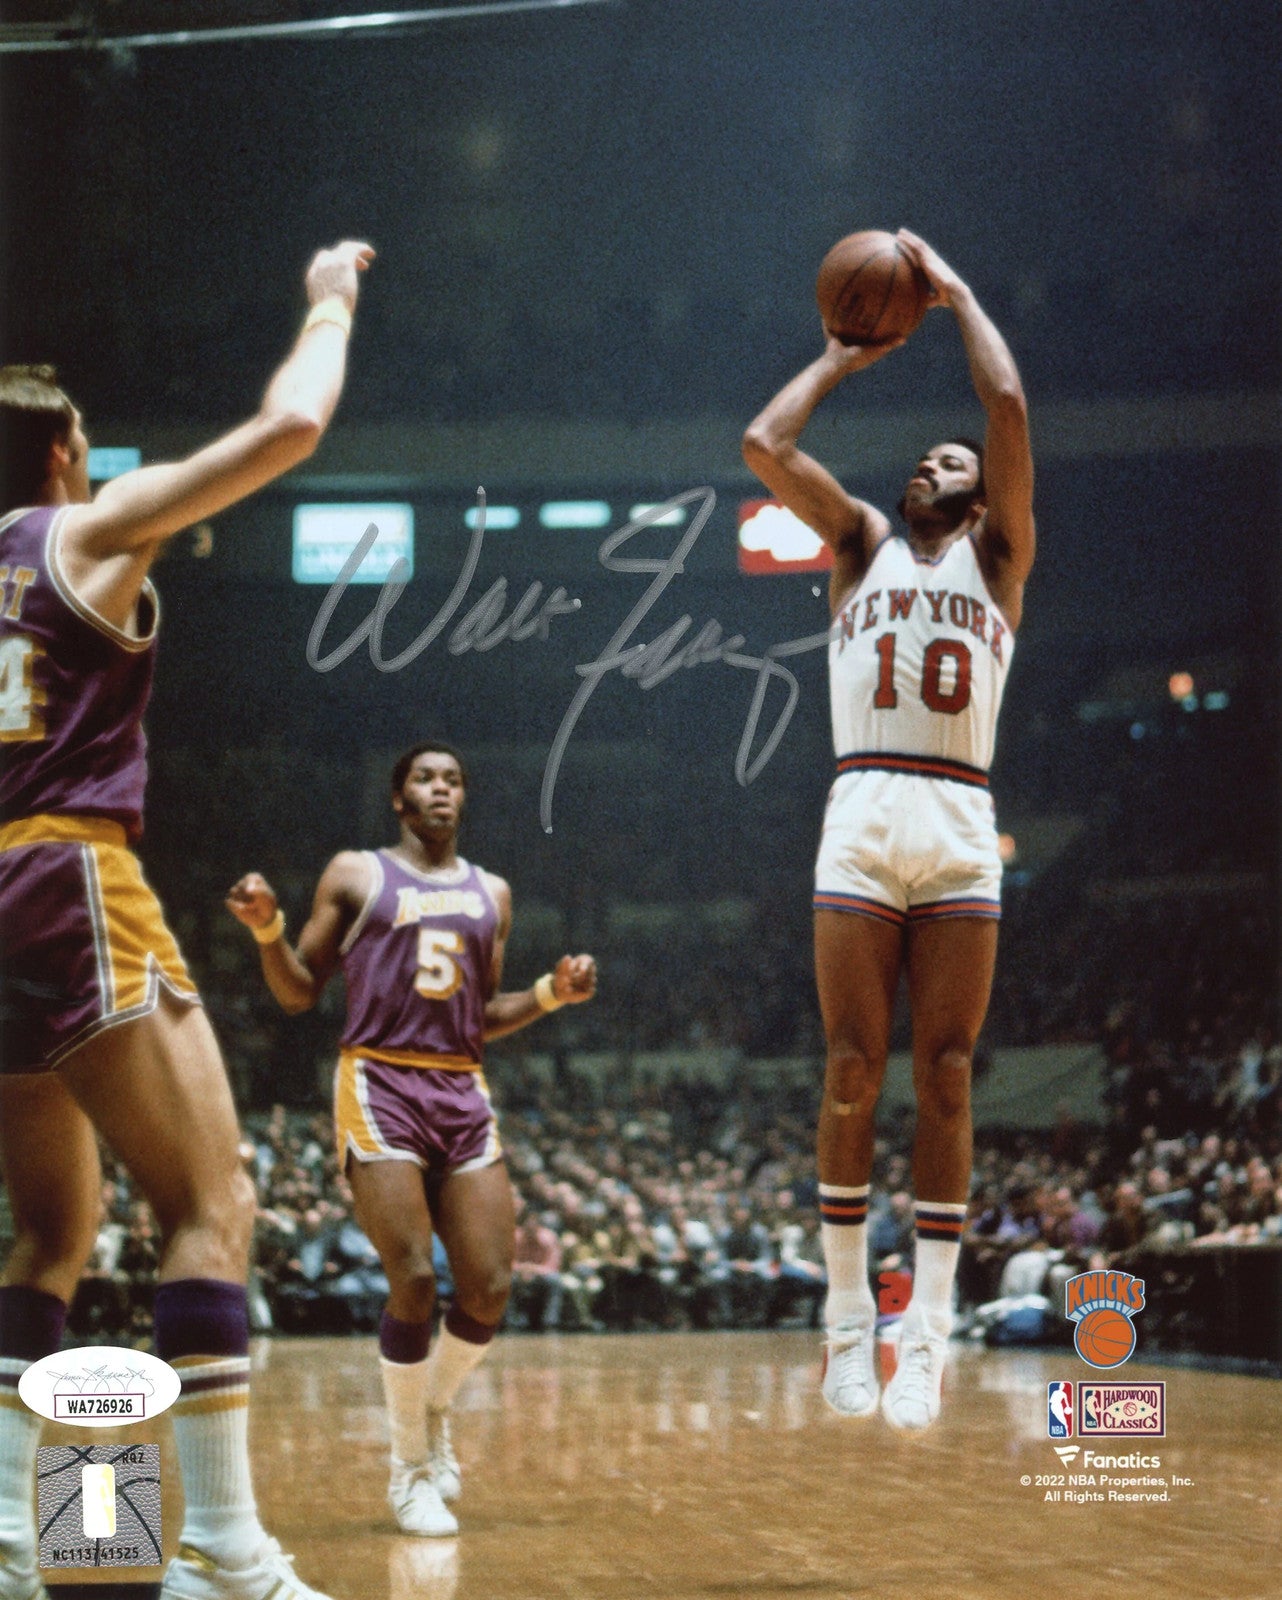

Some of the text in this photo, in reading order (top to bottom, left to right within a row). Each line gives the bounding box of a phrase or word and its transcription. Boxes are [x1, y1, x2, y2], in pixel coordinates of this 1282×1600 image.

[840, 588, 1006, 668] NEW YORK
[874, 632, 972, 714] 10
[414, 928, 465, 1000] 5
[67, 1399, 133, 1414] WA726926
[122, 1453, 145, 1463] RQZ
[53, 1547, 139, 1560] NC113741525
